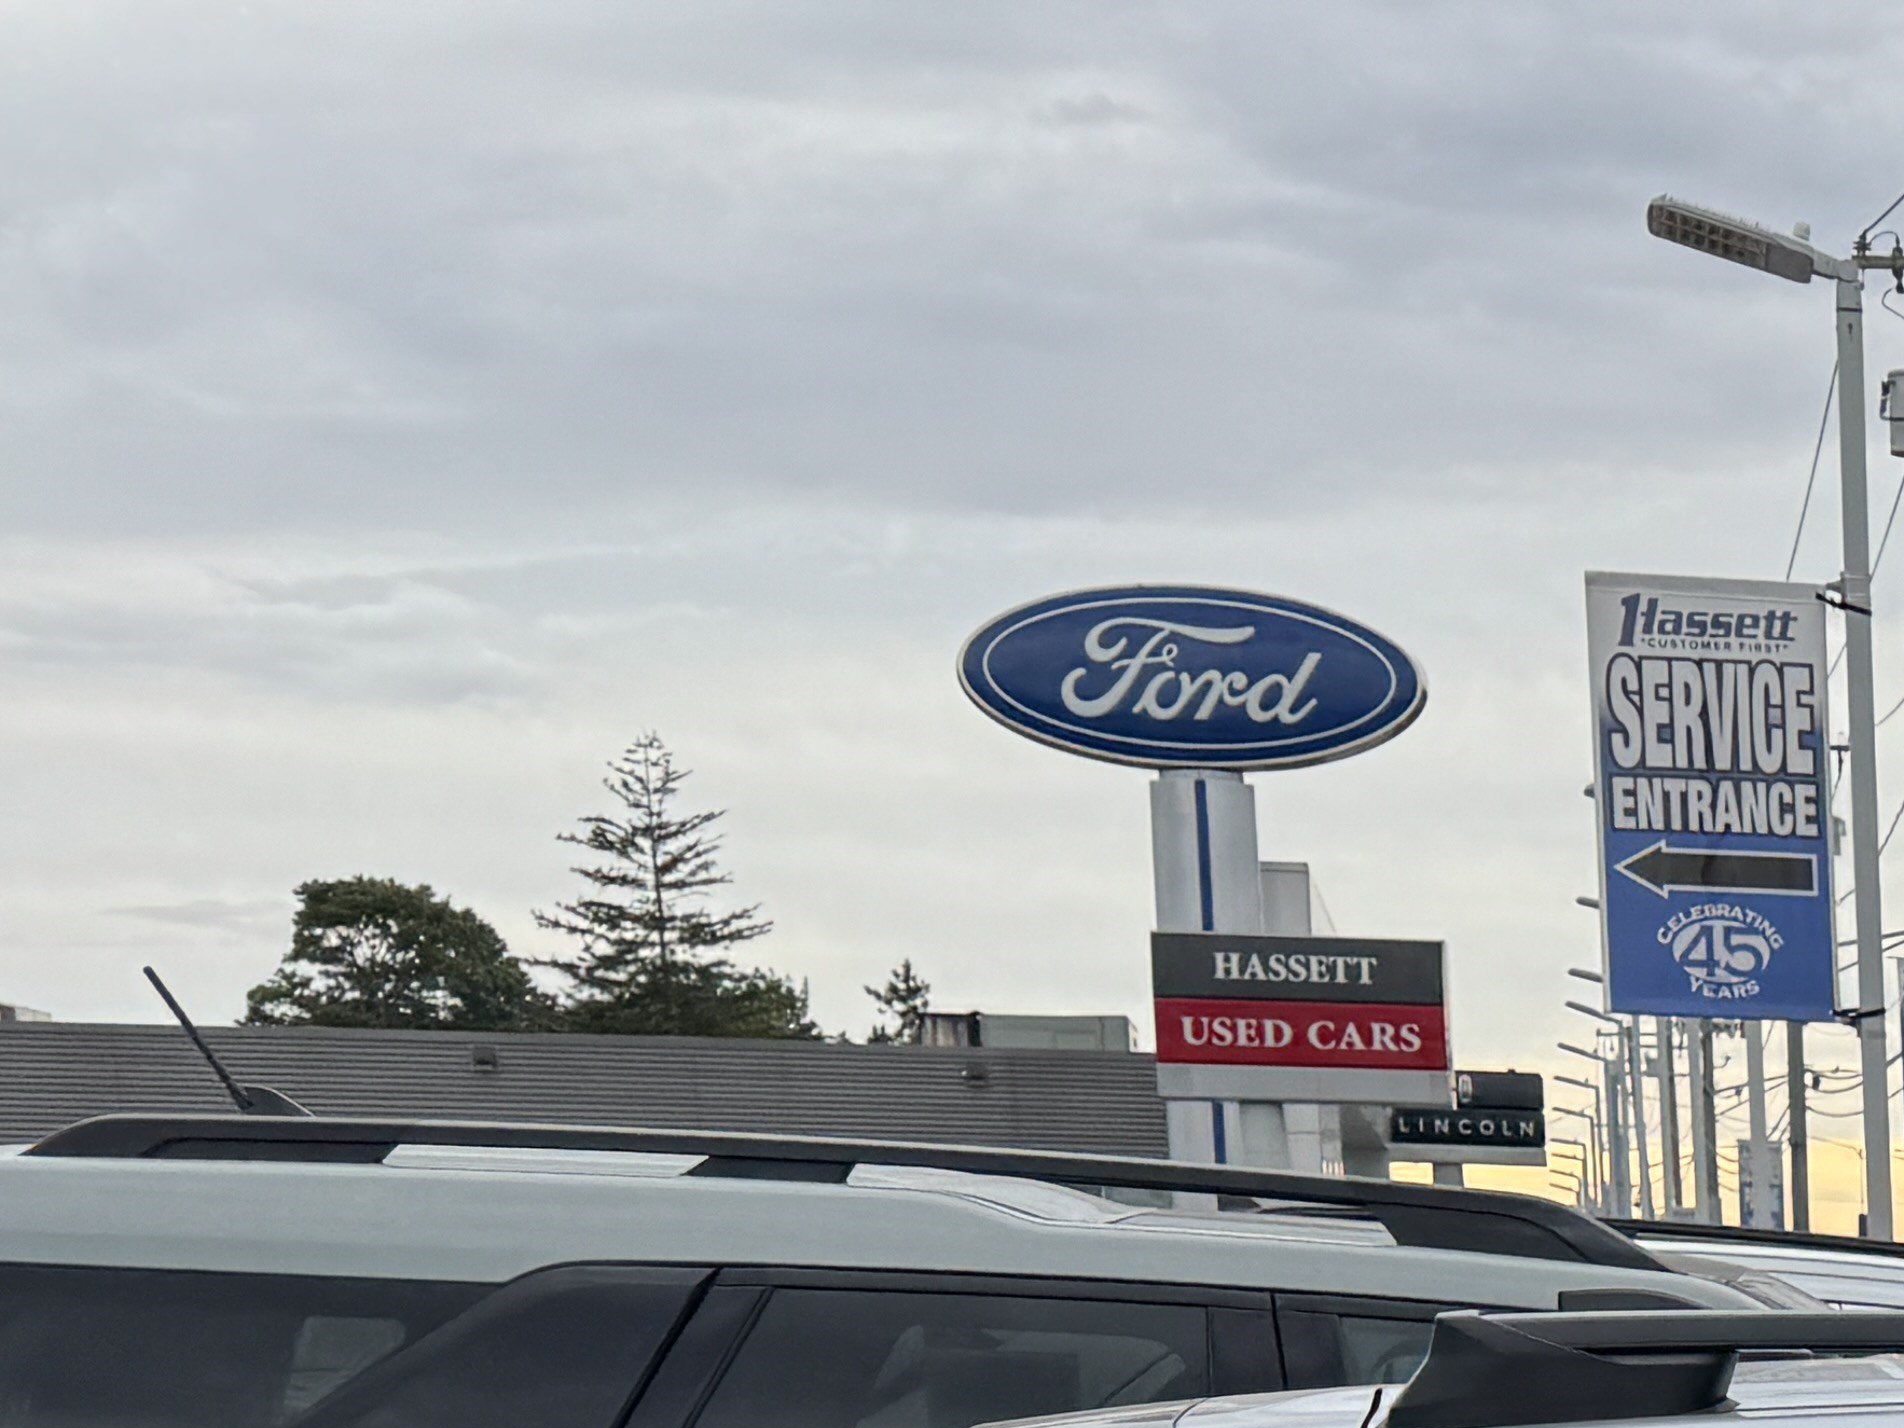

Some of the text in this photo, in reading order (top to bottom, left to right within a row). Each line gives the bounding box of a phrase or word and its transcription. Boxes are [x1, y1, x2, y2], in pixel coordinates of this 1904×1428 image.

[1061, 616, 1323, 725] Ford
[1606, 652, 1815, 777] SERVICE
[1611, 775, 1820, 837] ENTRANCE
[1656, 903, 1785, 950] CELEBRATING
[1212, 951, 1377, 985] HASSETT
[1678, 924, 1764, 978] 45
[1689, 975, 1760, 999] YEARS
[1181, 1015, 1422, 1053] USED CARS
[1398, 1116, 1537, 1138] LINCOLN
